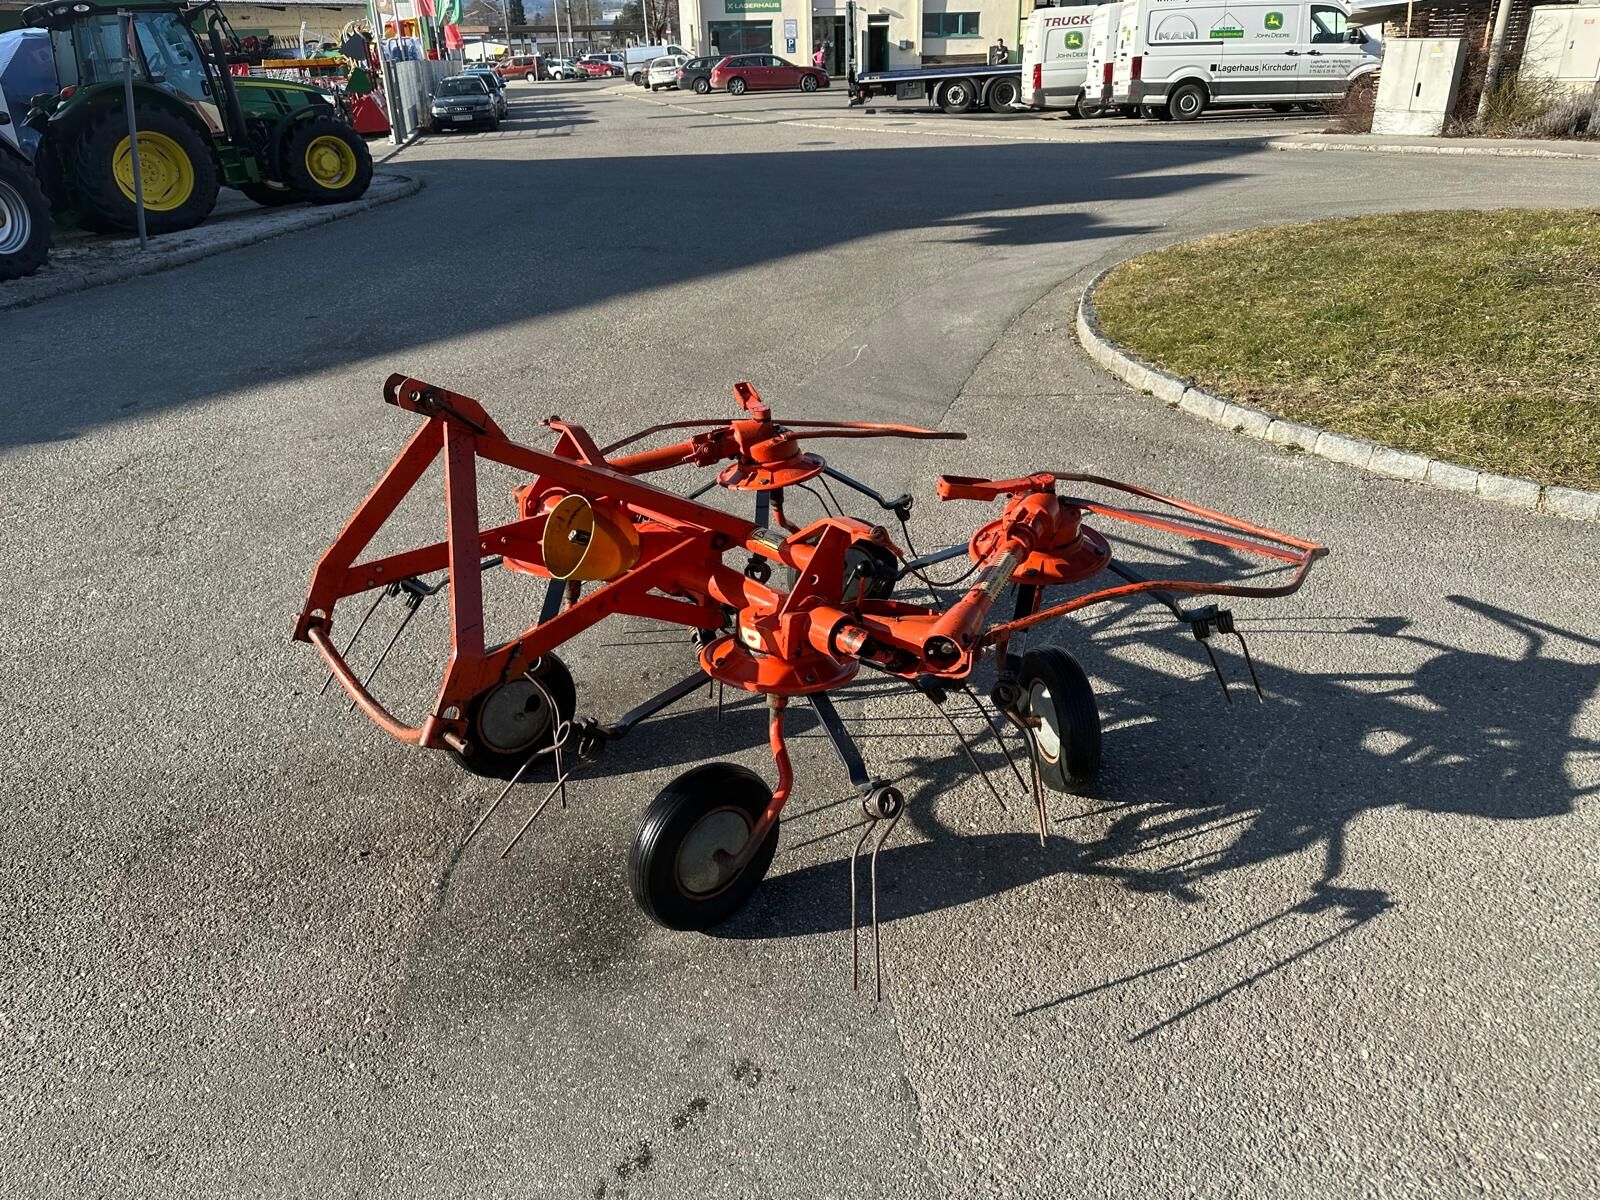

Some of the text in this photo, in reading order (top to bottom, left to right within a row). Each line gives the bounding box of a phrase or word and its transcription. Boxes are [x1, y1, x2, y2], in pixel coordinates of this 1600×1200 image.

[1158, 31, 1195, 40] MAN
[1217, 63, 1298, 73] Lagerhaus Kirchdorf
